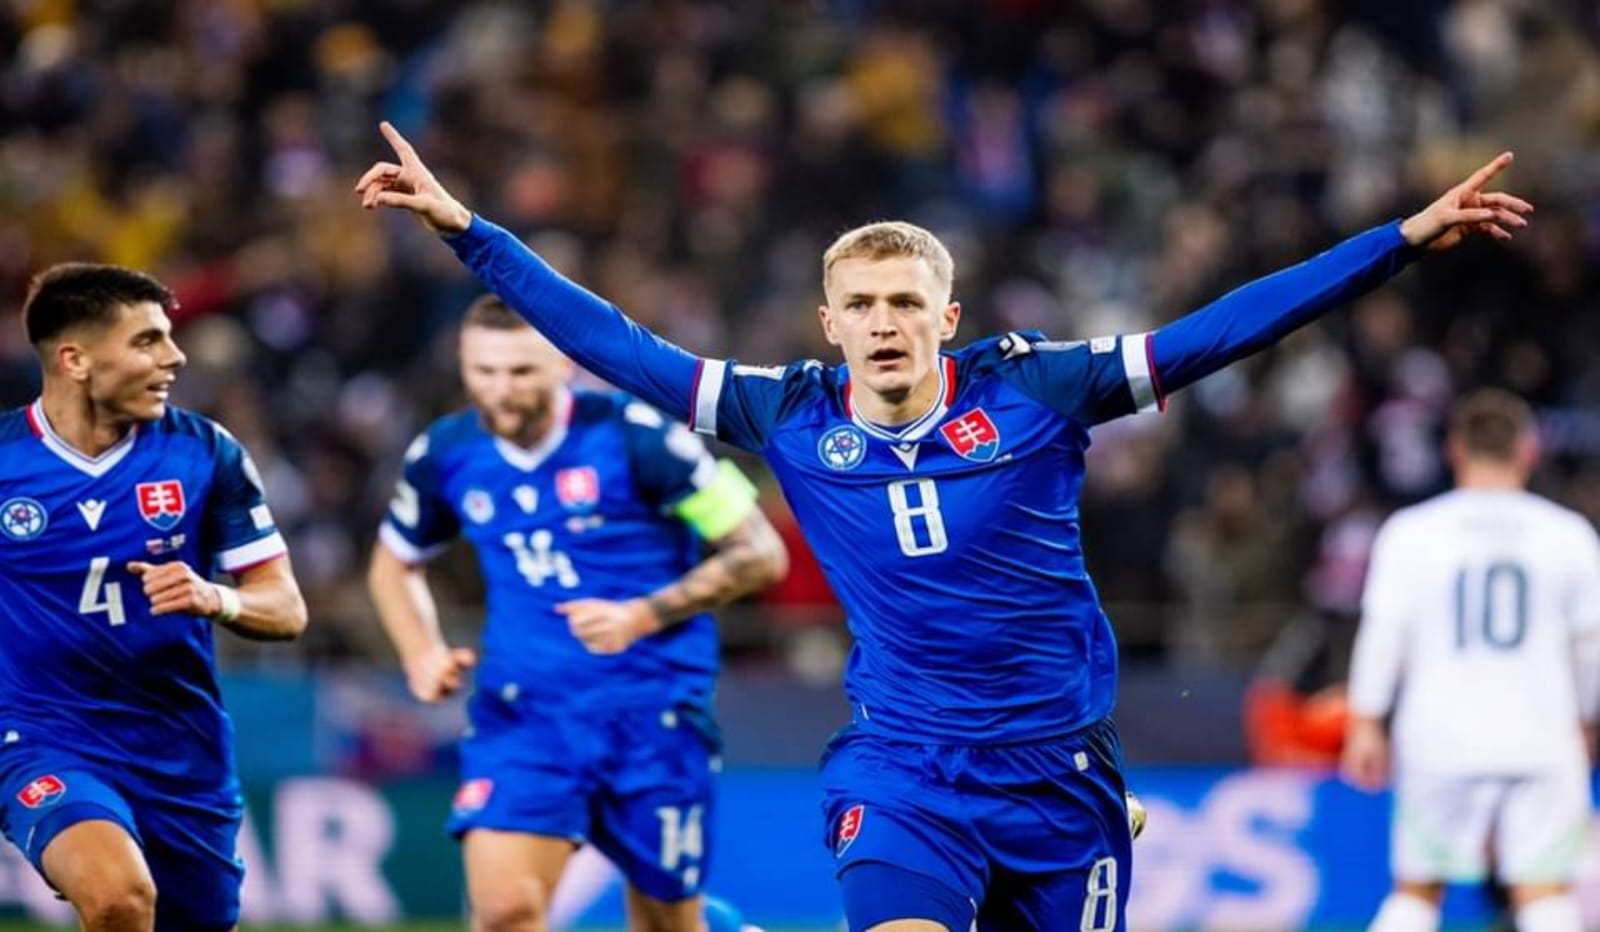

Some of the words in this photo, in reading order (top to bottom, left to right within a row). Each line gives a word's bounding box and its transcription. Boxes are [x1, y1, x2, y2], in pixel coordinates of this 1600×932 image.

[887, 478, 948, 557] 8
[79, 557, 126, 627] 4
[503, 529, 579, 588] 14
[1454, 562, 1530, 650] 10
[656, 805, 704, 871] 14
[1081, 856, 1118, 932] 8
